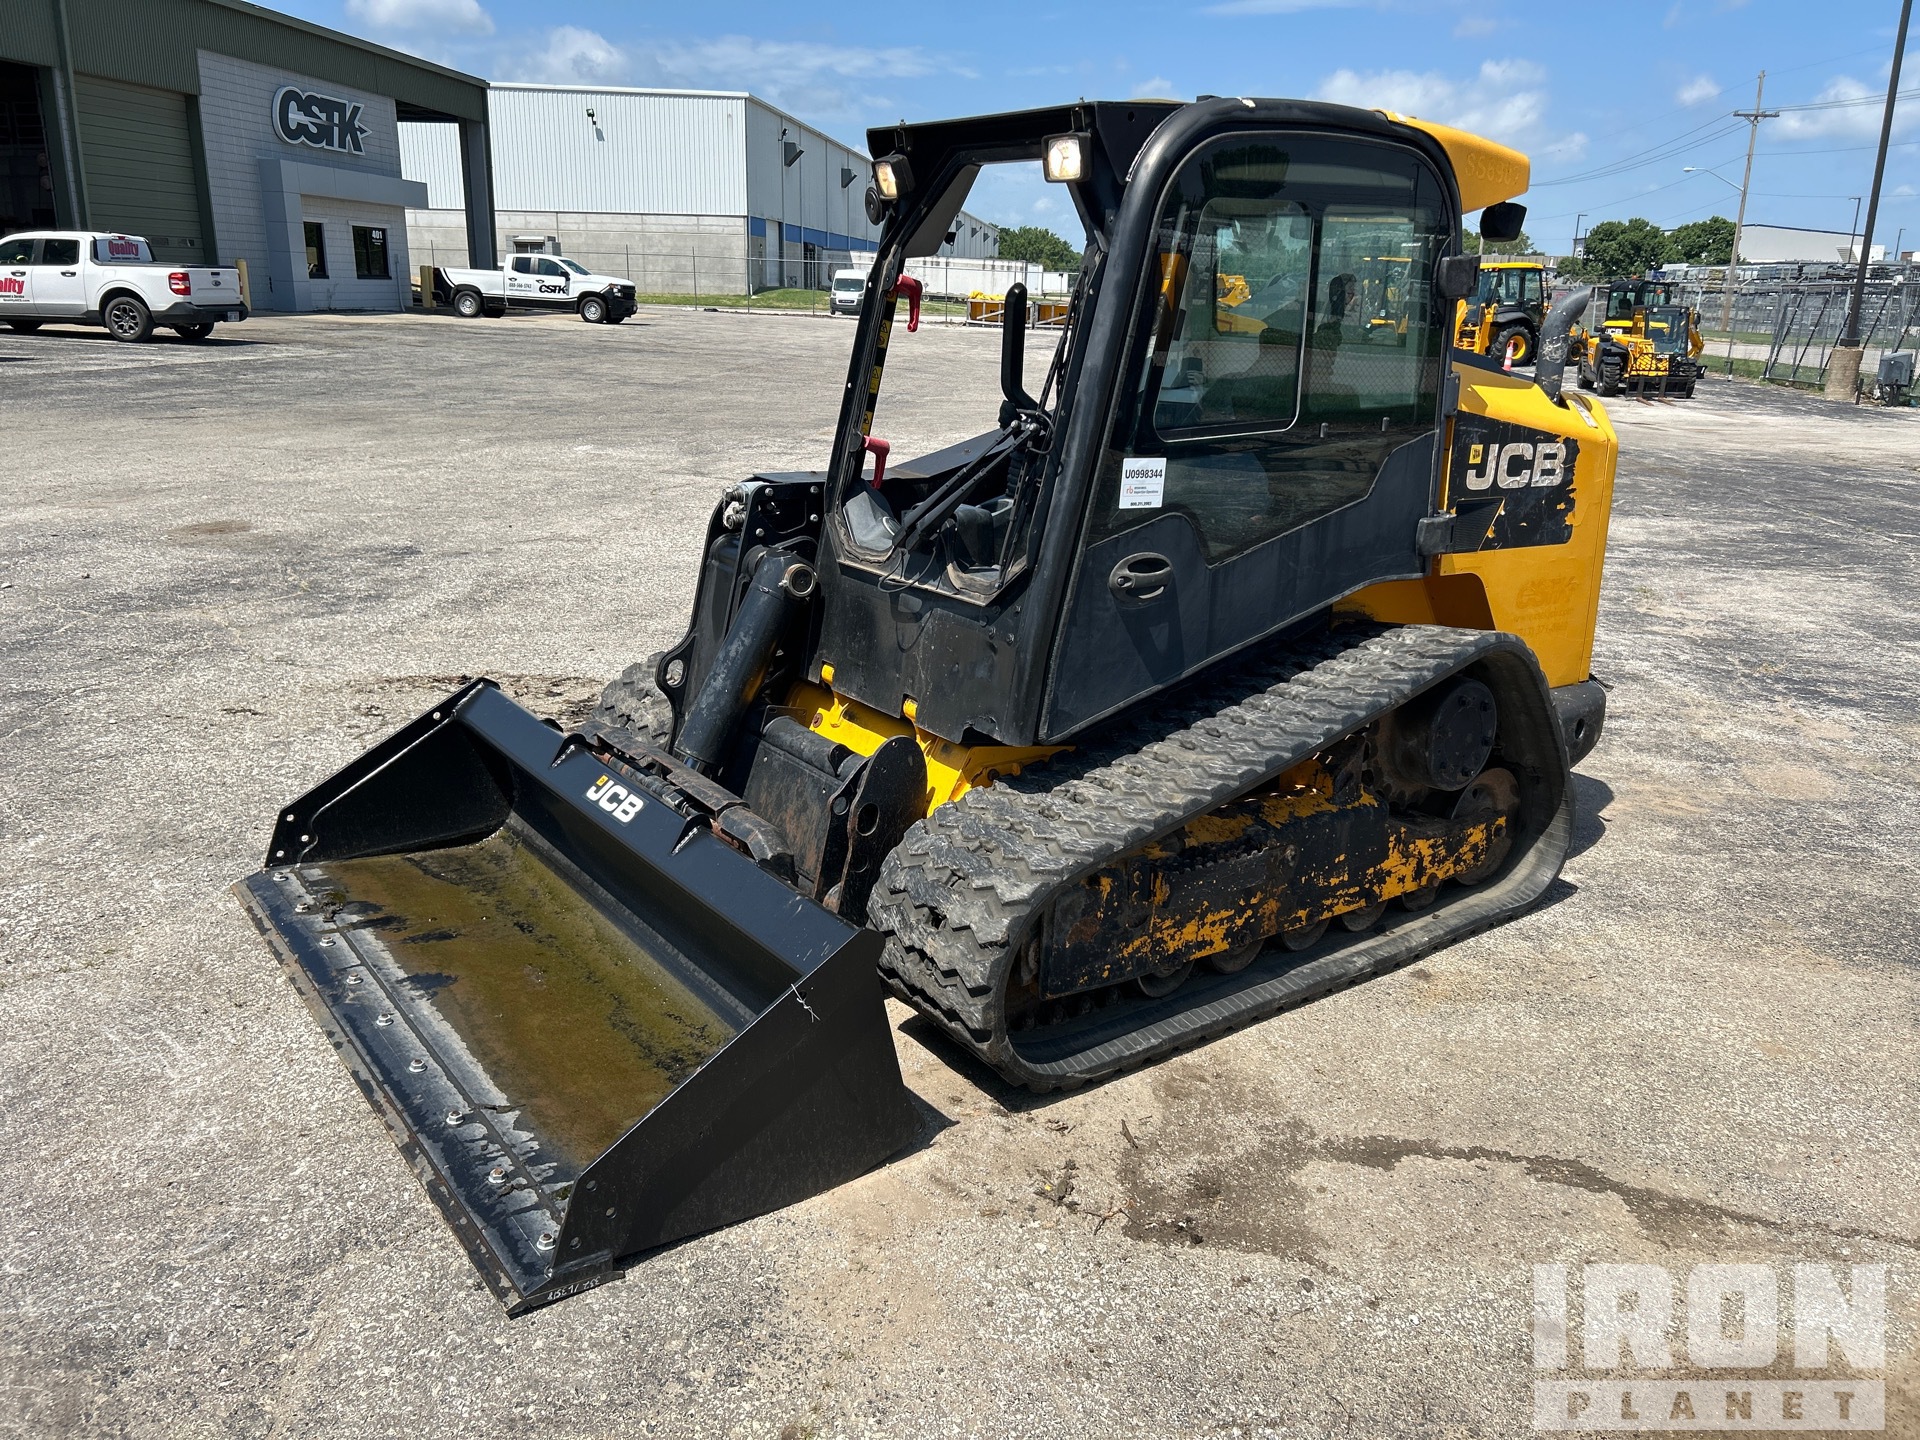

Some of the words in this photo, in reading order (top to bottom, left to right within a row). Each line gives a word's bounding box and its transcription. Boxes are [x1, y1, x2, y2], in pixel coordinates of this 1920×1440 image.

[276, 87, 369, 154] CSTK
[372, 230, 383, 239] 401
[108, 240, 139, 256] Quality
[539, 284, 568, 294] CSTK
[1125, 469, 1163, 479] U0998344
[1466, 443, 1566, 490] JCB
[586, 775, 644, 823] JCB
